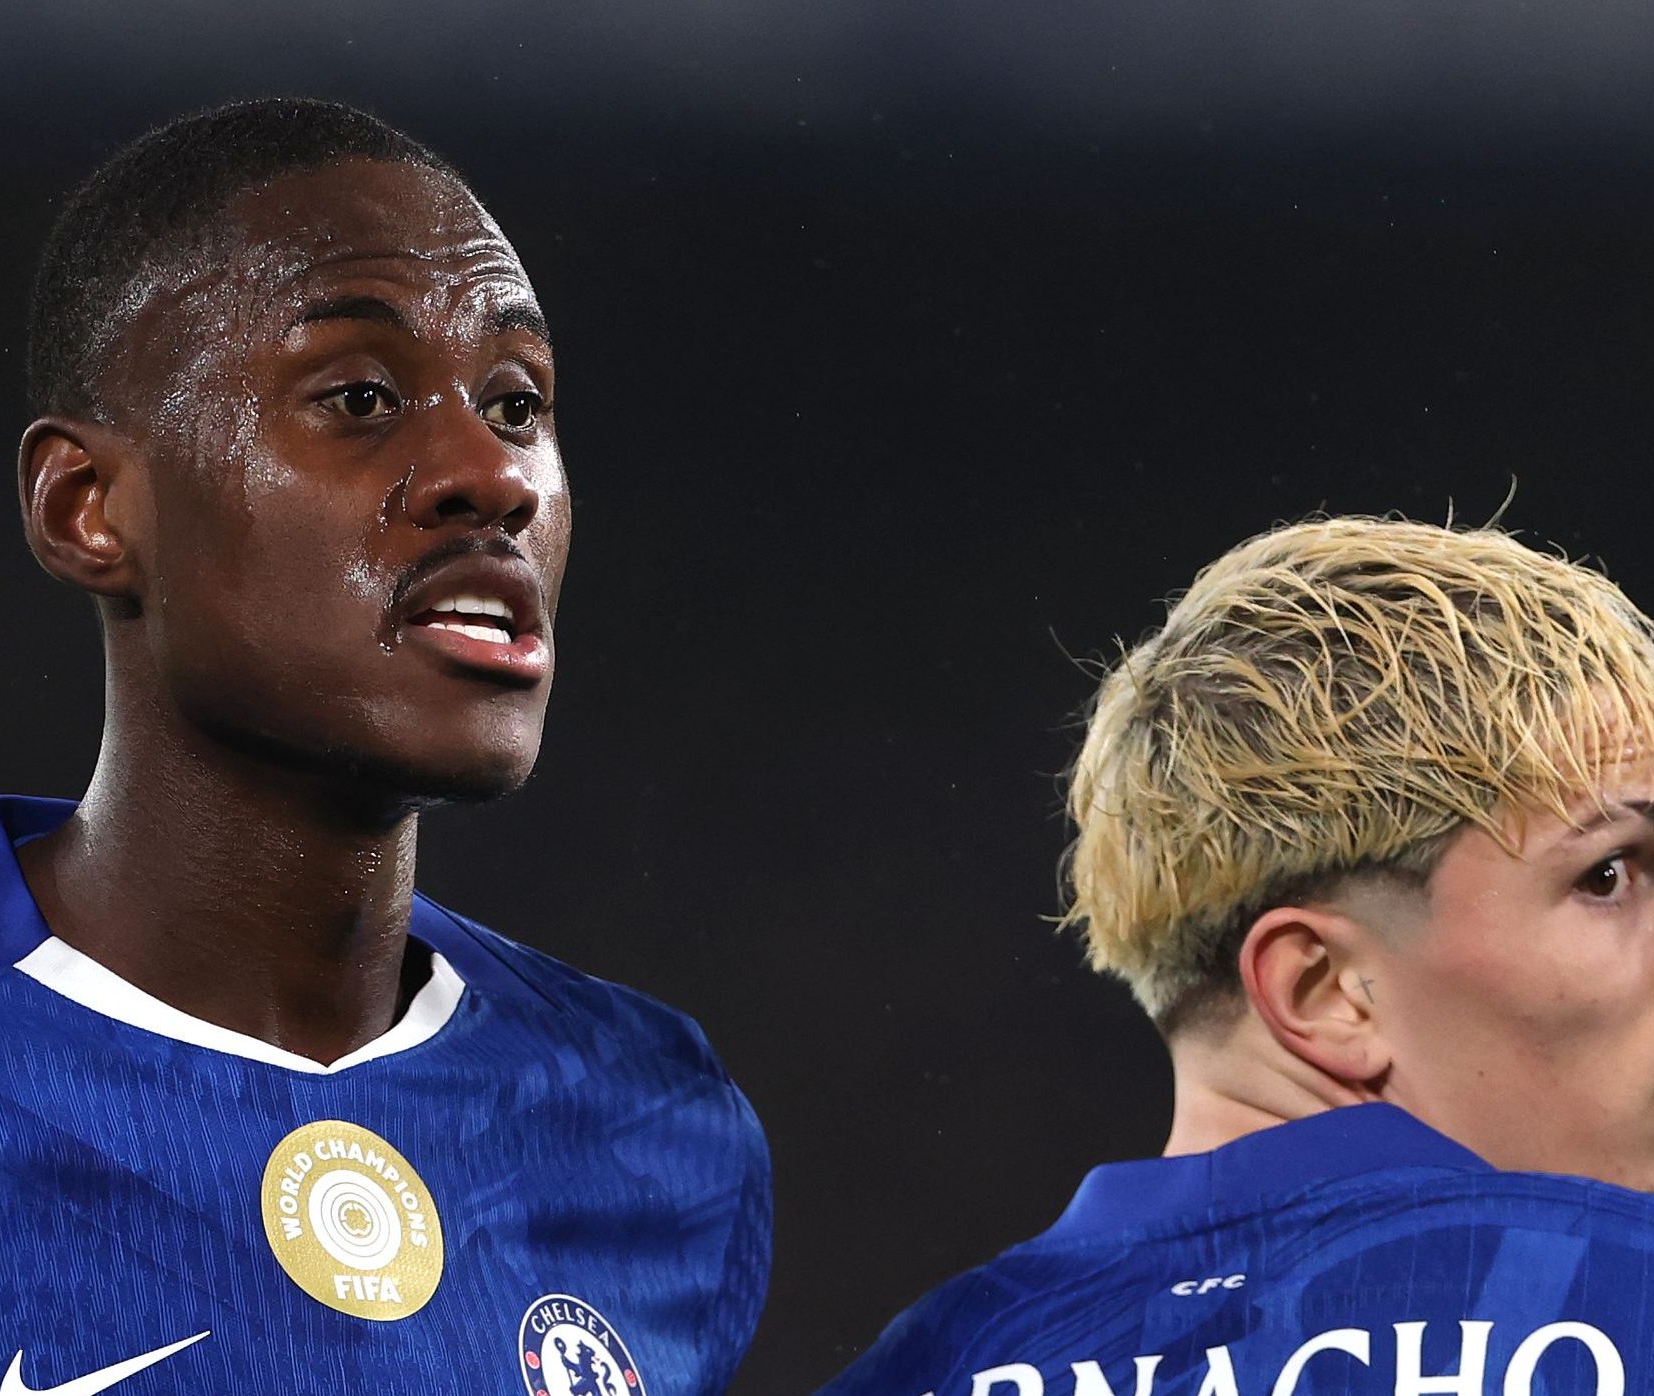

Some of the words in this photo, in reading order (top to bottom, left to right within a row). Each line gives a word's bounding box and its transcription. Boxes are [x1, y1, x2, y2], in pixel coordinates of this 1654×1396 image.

[278, 1151, 313, 1241] WORLD
[313, 1138, 429, 1248] CHAMPIONS
[333, 1274, 403, 1304] FIFA
[1170, 1273, 1246, 1297] CFC
[531, 1302, 610, 1348] CHELSEA
